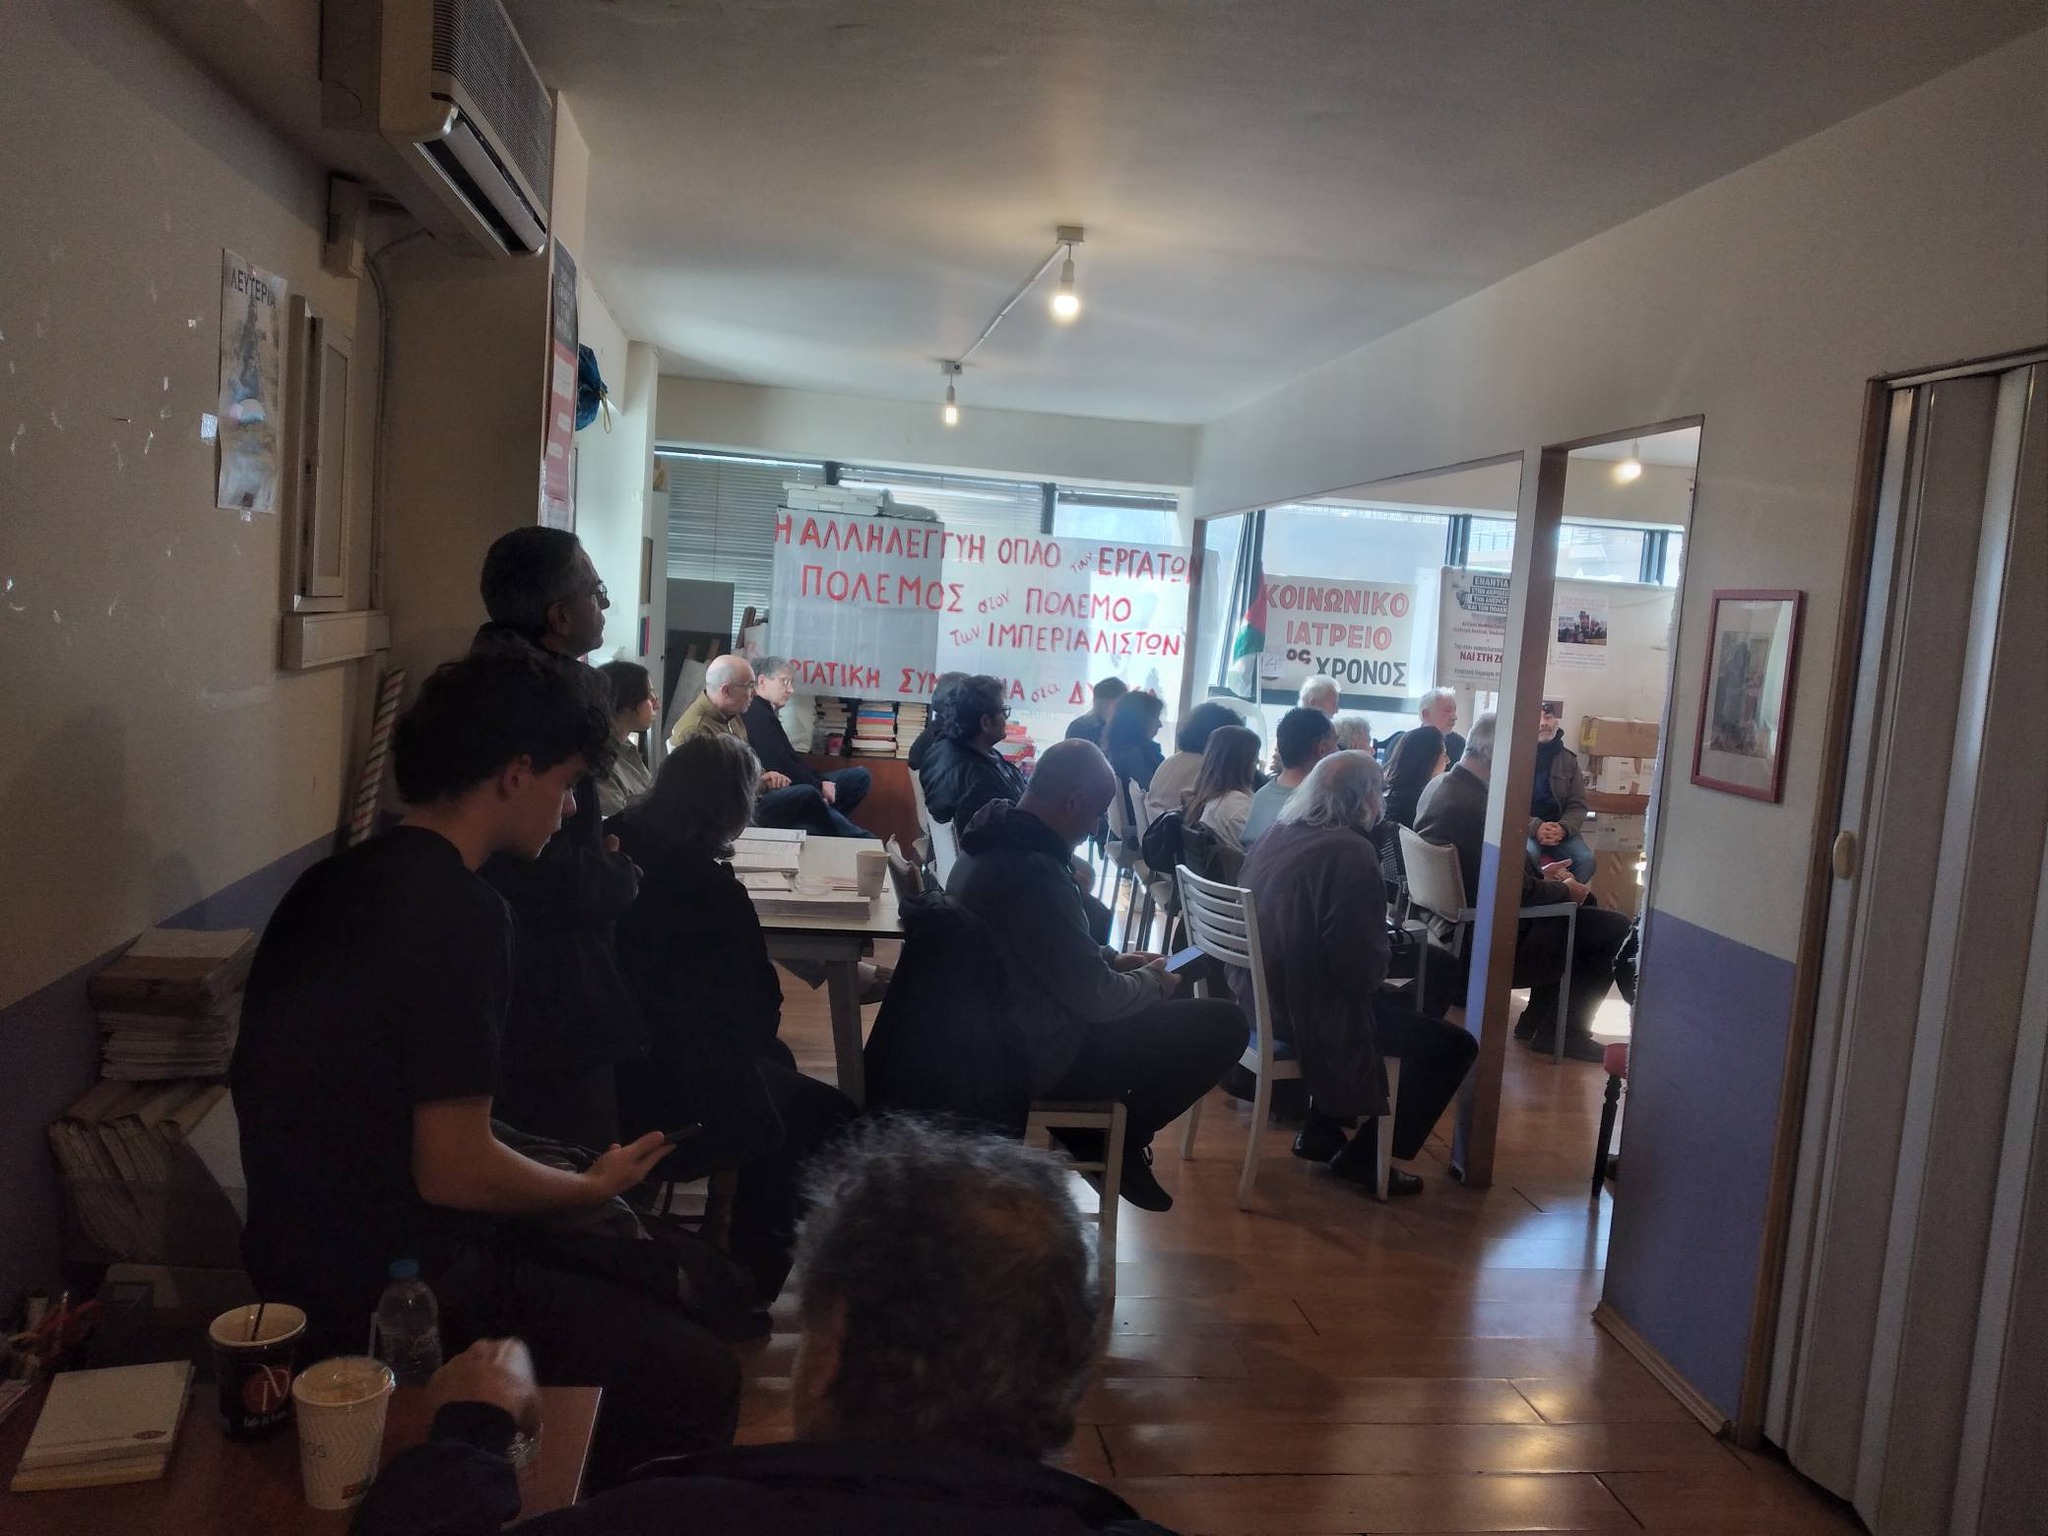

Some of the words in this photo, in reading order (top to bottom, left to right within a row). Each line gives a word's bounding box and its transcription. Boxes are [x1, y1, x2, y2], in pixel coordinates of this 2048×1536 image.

[775, 513, 792, 544] Η
[800, 517, 986, 562] ΑΛΛΗΛΕΓΓΥΗ
[998, 537, 1061, 568] ΟΠΛΟ
[801, 564, 964, 612] ΠΟΛΕΜΟΣ
[1025, 588, 1132, 622] ΠΟΛΕΜΟ
[1264, 584, 1410, 618] ΚΟΙΝΩΝΙΚΟ
[987, 622, 1181, 656] ΙΜΠΕΡΙΑΛΙΣΤΩΝ
[1286, 620, 1392, 651] ΙΑΤΡΕΙΟ
[1315, 656, 1407, 687] ΧΡΟΝΟΣ
[1460, 651, 1475, 661] ΝΑΙ
[1477, 652, 1493, 663] ΣΤΗ
[787, 659, 880, 689] ΡΓΑΤΙΚΗ
